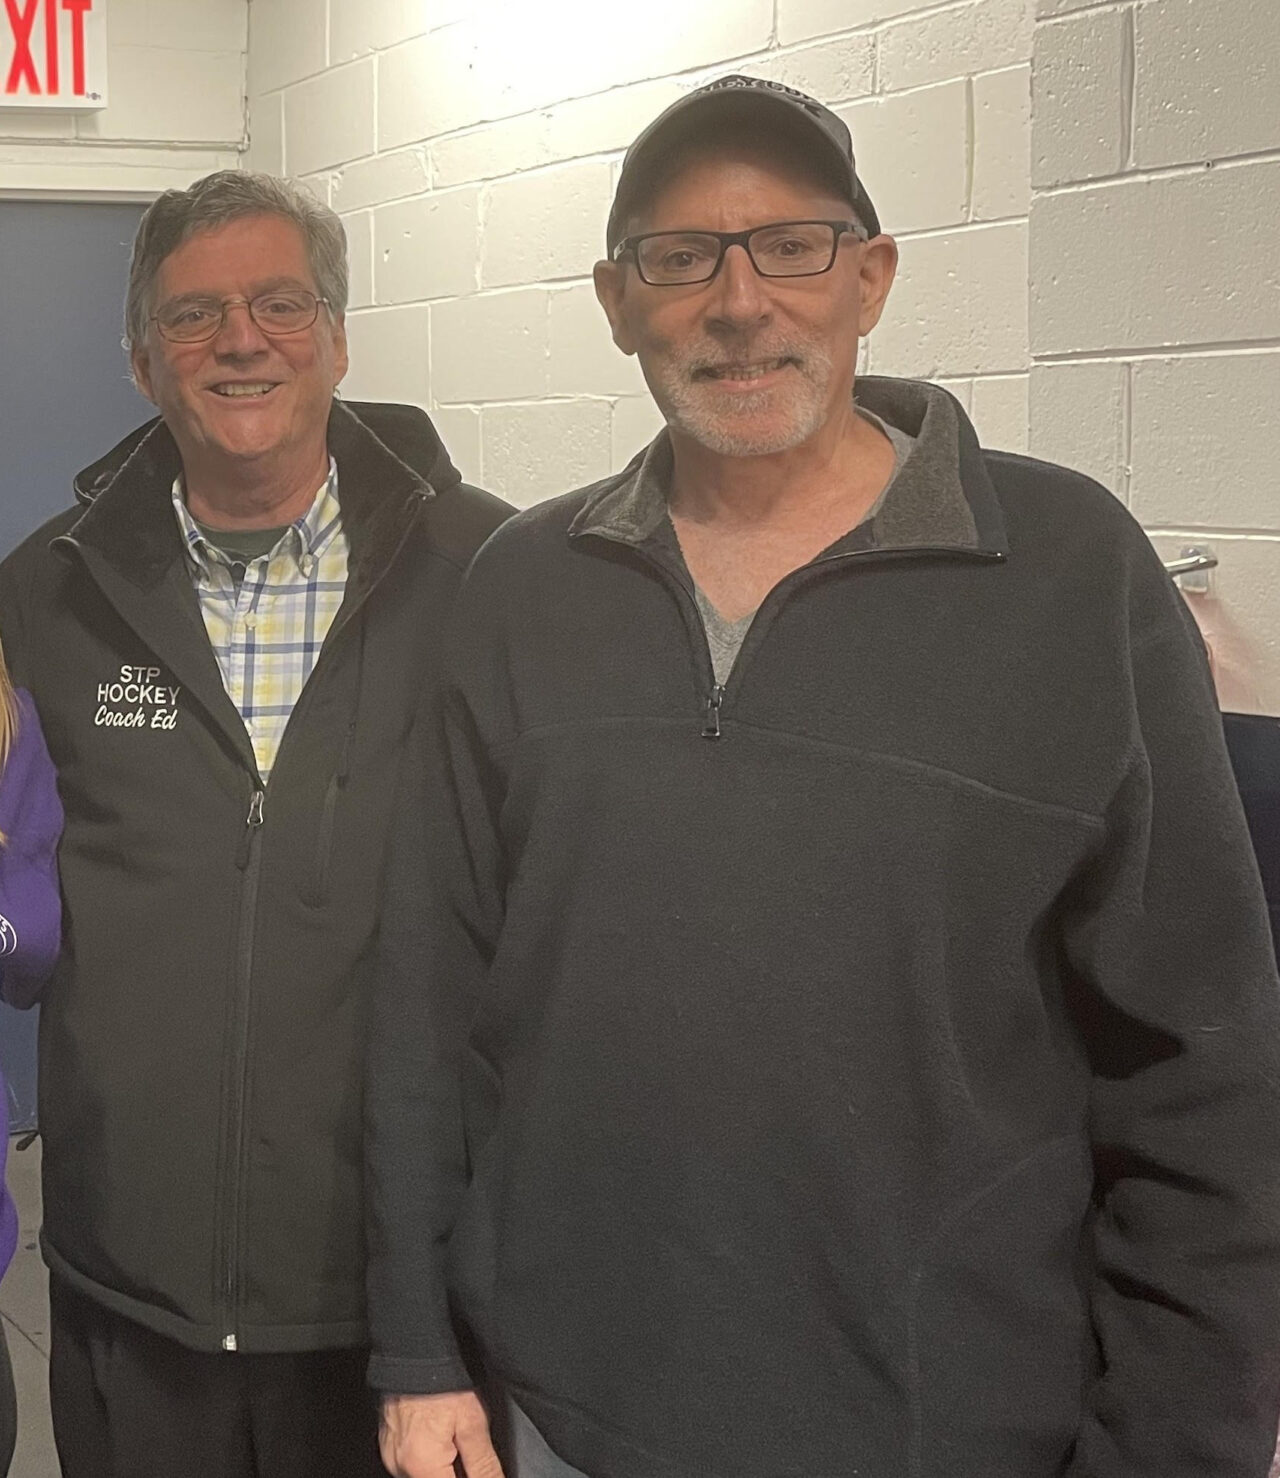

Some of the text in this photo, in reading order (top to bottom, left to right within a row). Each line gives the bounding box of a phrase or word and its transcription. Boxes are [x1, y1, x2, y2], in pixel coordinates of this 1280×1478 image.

[120, 665, 161, 683] STP
[97, 683, 181, 706] HOCKEY
[94, 705, 178, 730] Coach Ed
